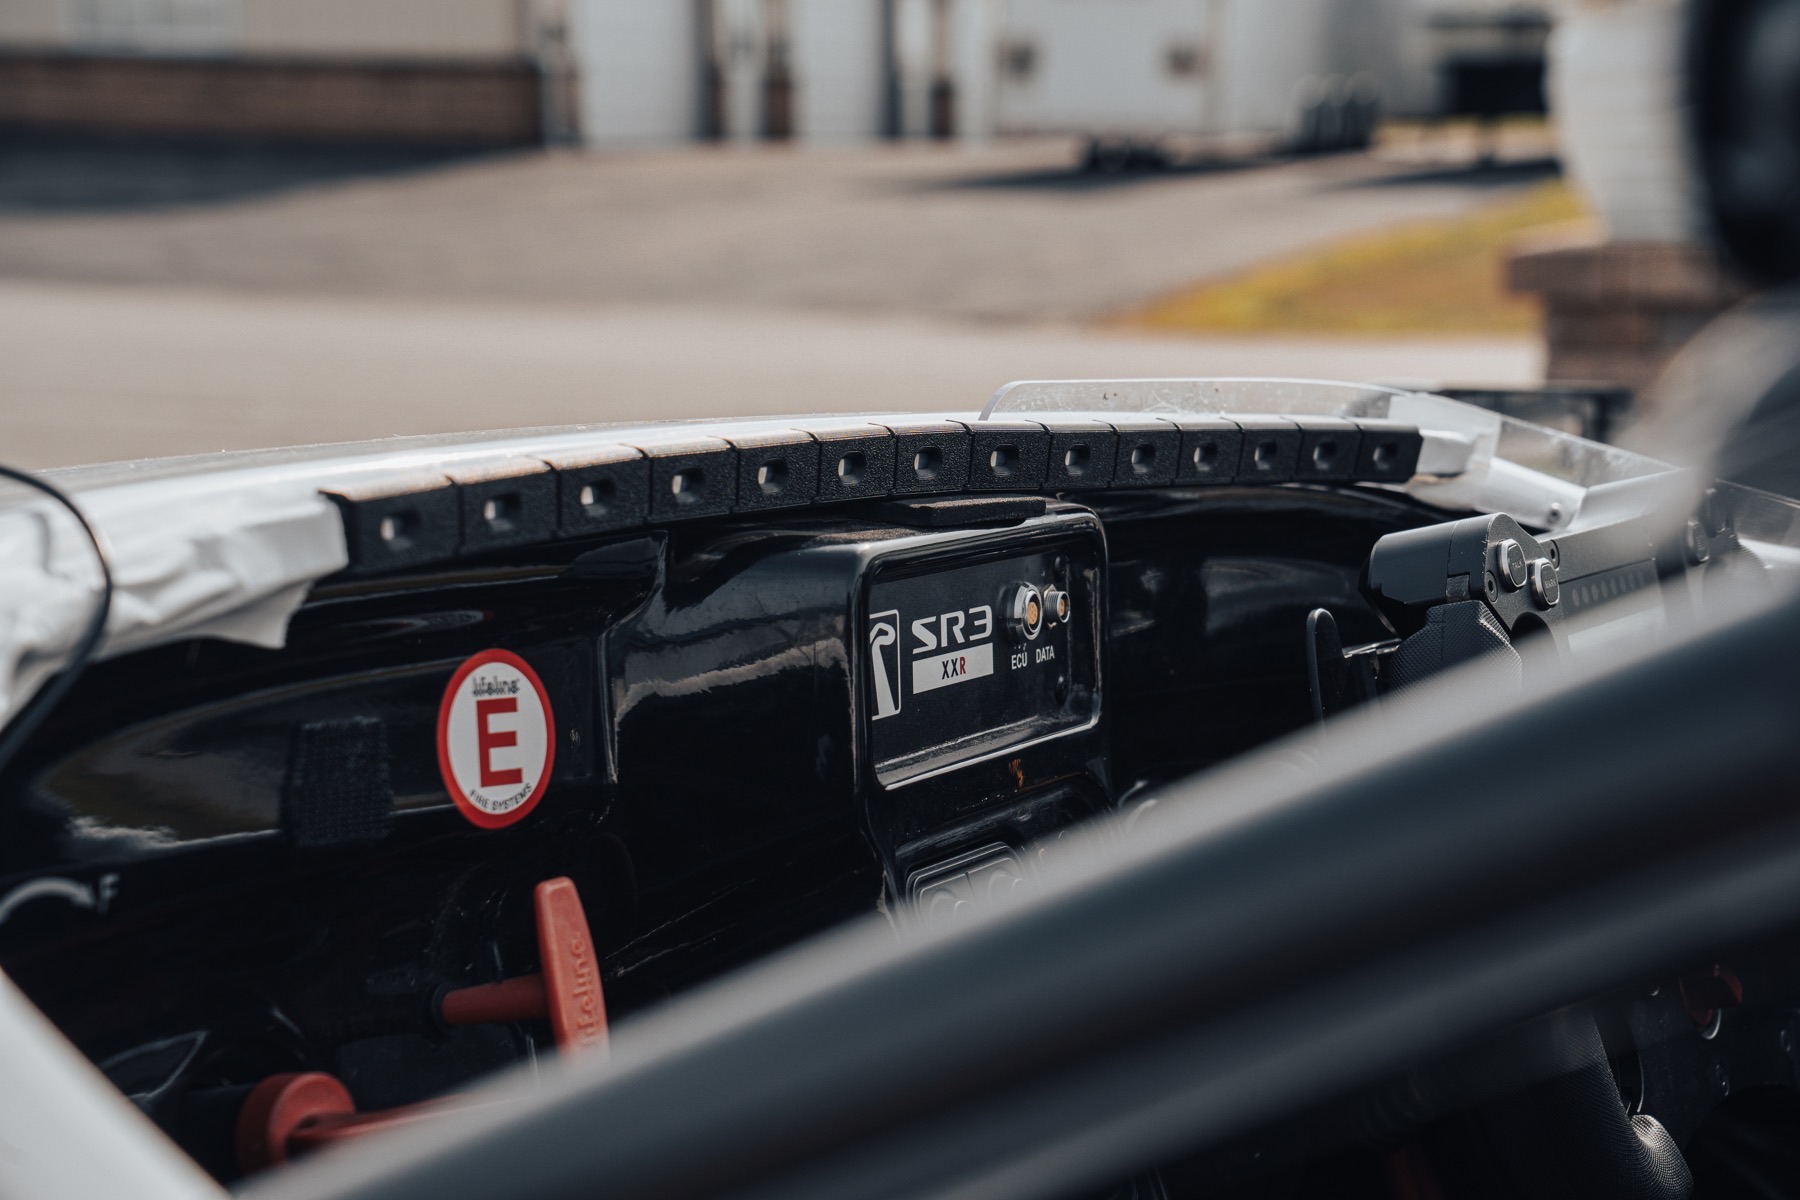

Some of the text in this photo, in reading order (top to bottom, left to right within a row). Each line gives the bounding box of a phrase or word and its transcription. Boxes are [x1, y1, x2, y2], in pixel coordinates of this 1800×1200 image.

[911, 604, 993, 655] SR3
[1011, 651, 1028, 670] ECU
[1035, 644, 1055, 664] DATA
[941, 656, 967, 680] XXR
[476, 697, 523, 787] E
[470, 782, 533, 810] FIRE SYSTEMS
